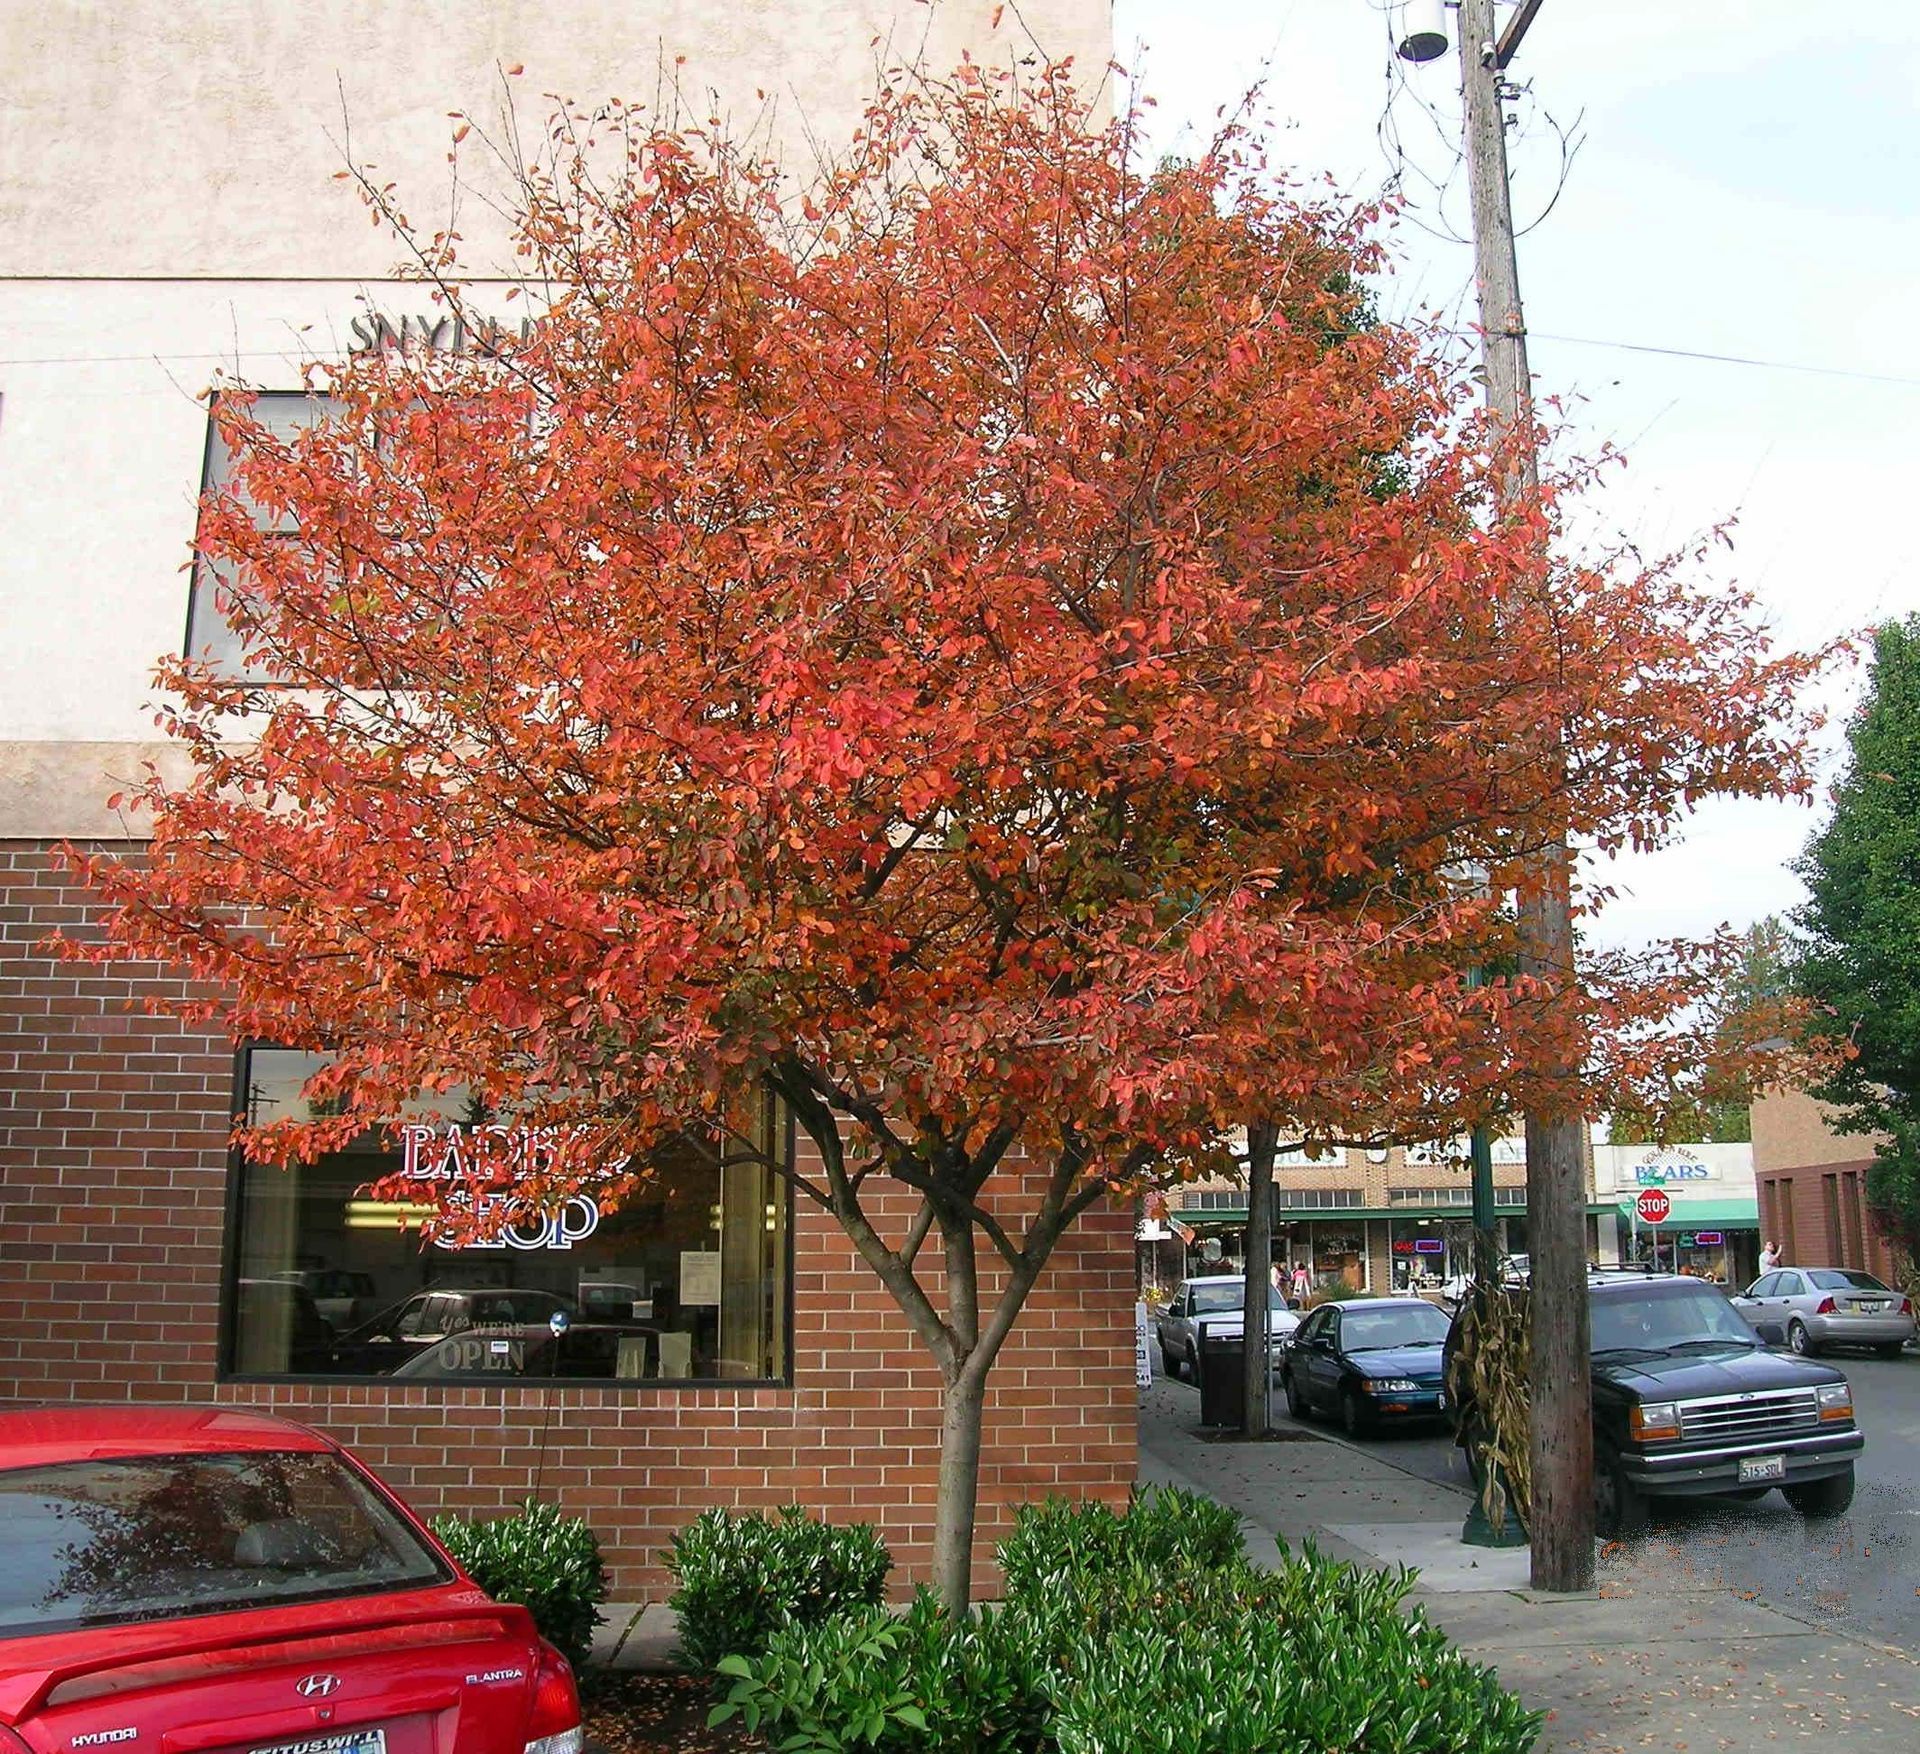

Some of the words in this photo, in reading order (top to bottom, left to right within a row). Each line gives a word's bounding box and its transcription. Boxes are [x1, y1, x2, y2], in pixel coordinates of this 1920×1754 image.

[1638, 1198, 1669, 1213] STOP
[440, 1340, 526, 1371] OPEN
[465, 1668, 523, 1685] ELANTRA
[71, 1726, 137, 1748] HYUNDAI
